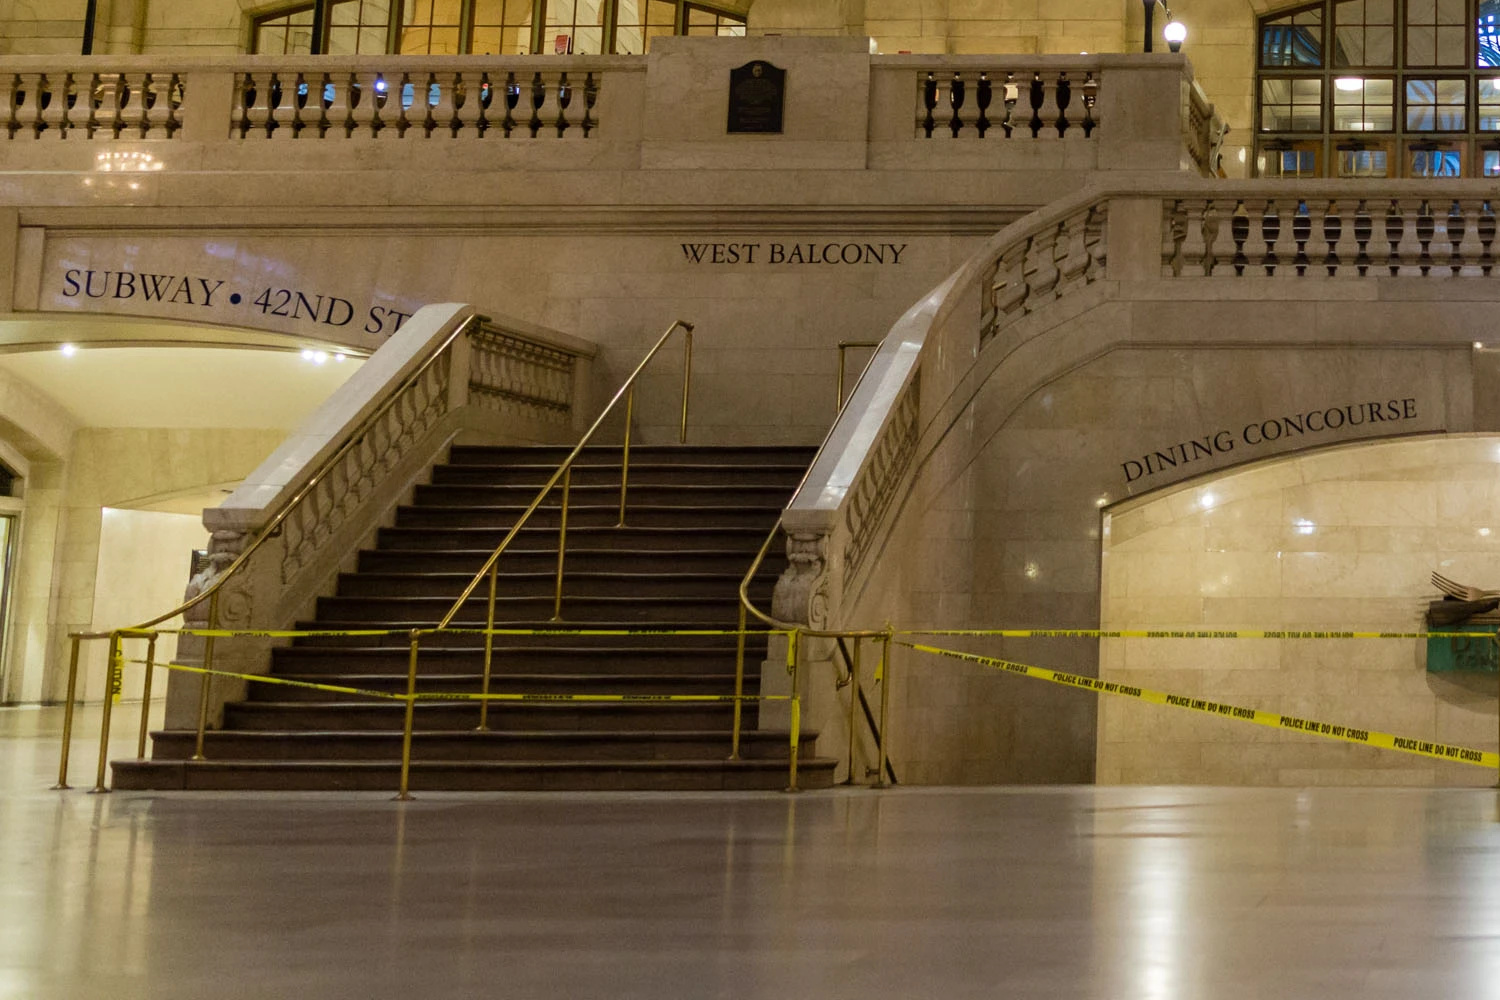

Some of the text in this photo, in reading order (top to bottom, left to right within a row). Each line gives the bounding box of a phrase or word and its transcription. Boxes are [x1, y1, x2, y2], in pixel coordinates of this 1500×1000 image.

[680, 243, 909, 265] WEST BALCONY
[62, 269, 224, 308] SUBWAY
[254, 287, 355, 327] 42ND
[1120, 398, 1418, 483] DINING CONCOURSE
[1053, 673, 1142, 697] POLICE LINE DO NOT CROSS
[1166, 695, 1255, 719] POLICE LINE DO NOT CROSS
[1280, 716, 1369, 741] POLICE LINE DO NOT CROSS
[1393, 736, 1482, 762] POLICE LINE DO NOT CROSS
